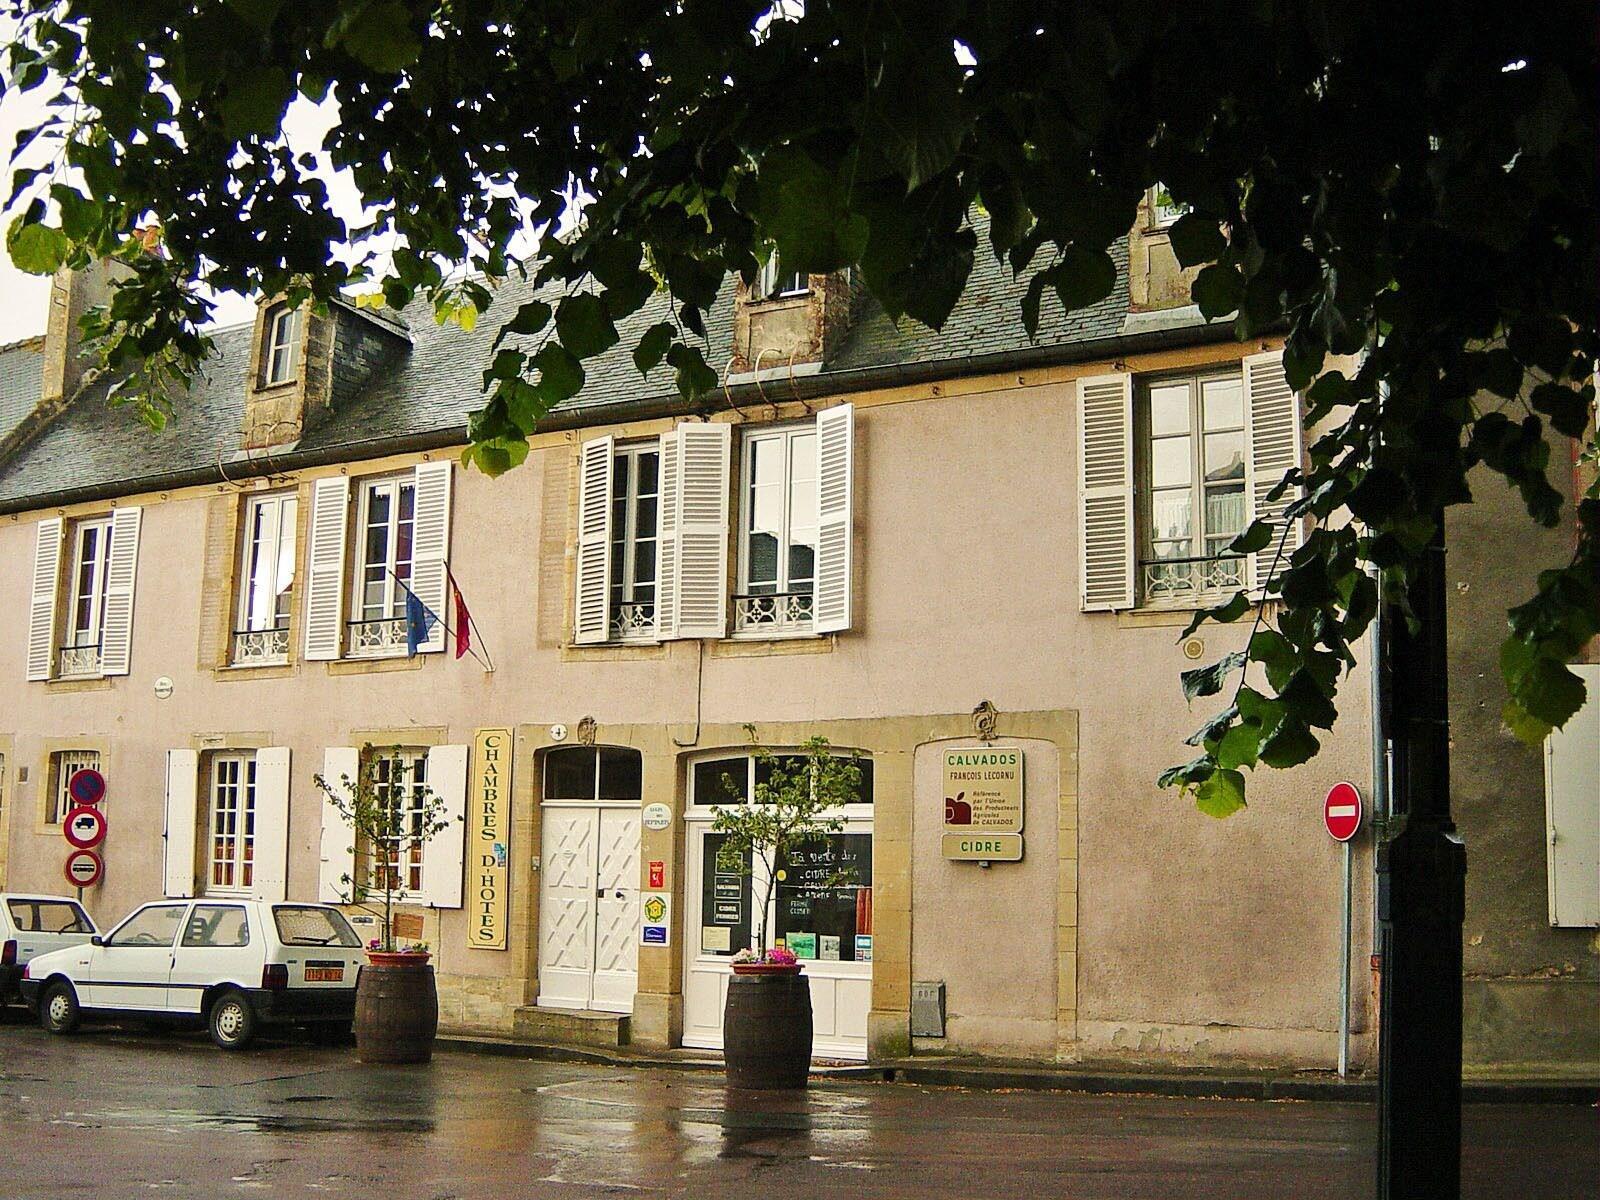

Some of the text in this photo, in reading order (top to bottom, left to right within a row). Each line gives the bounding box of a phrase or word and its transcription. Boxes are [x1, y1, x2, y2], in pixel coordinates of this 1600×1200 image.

[555, 727, 561, 737] 4
[948, 754, 1017, 766] CALVADOS
[950, 771, 1015, 780] FRANÇOIS LECORNU
[479, 736, 501, 940] CHAMBRES D'HOTES
[961, 841, 1002, 852] CIDRE
